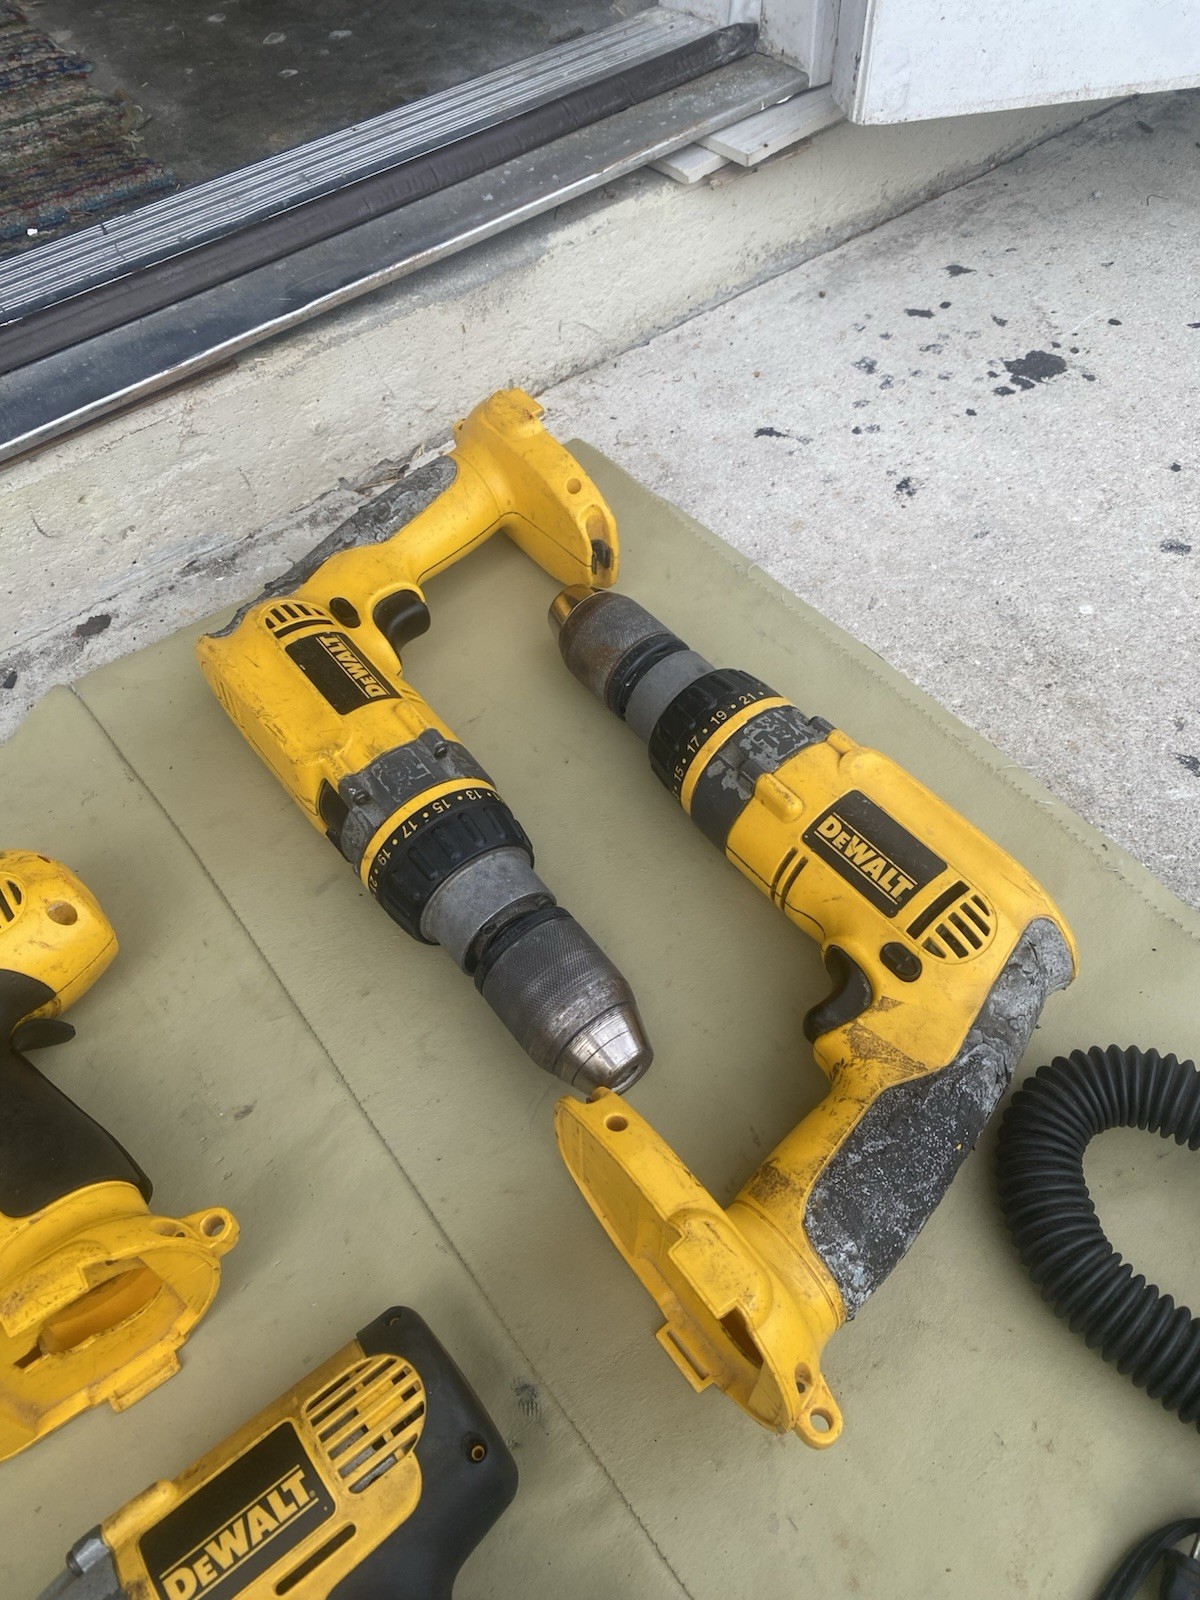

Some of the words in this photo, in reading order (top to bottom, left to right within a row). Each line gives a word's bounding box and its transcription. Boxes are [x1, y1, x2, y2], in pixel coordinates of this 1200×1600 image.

[318, 635, 388, 698] DEWALT
[673, 765, 684, 782] 15
[686, 735, 700, 753] 17
[709, 710, 728, 725] 19
[738, 692, 757, 705] 21
[432, 799, 452, 814] 15
[465, 789, 483, 801] 13
[401, 820, 419, 839] 17
[377, 848, 392, 866] 19
[816, 814, 915, 899] DEWALT
[161, 1469, 311, 1600] DEWALT
